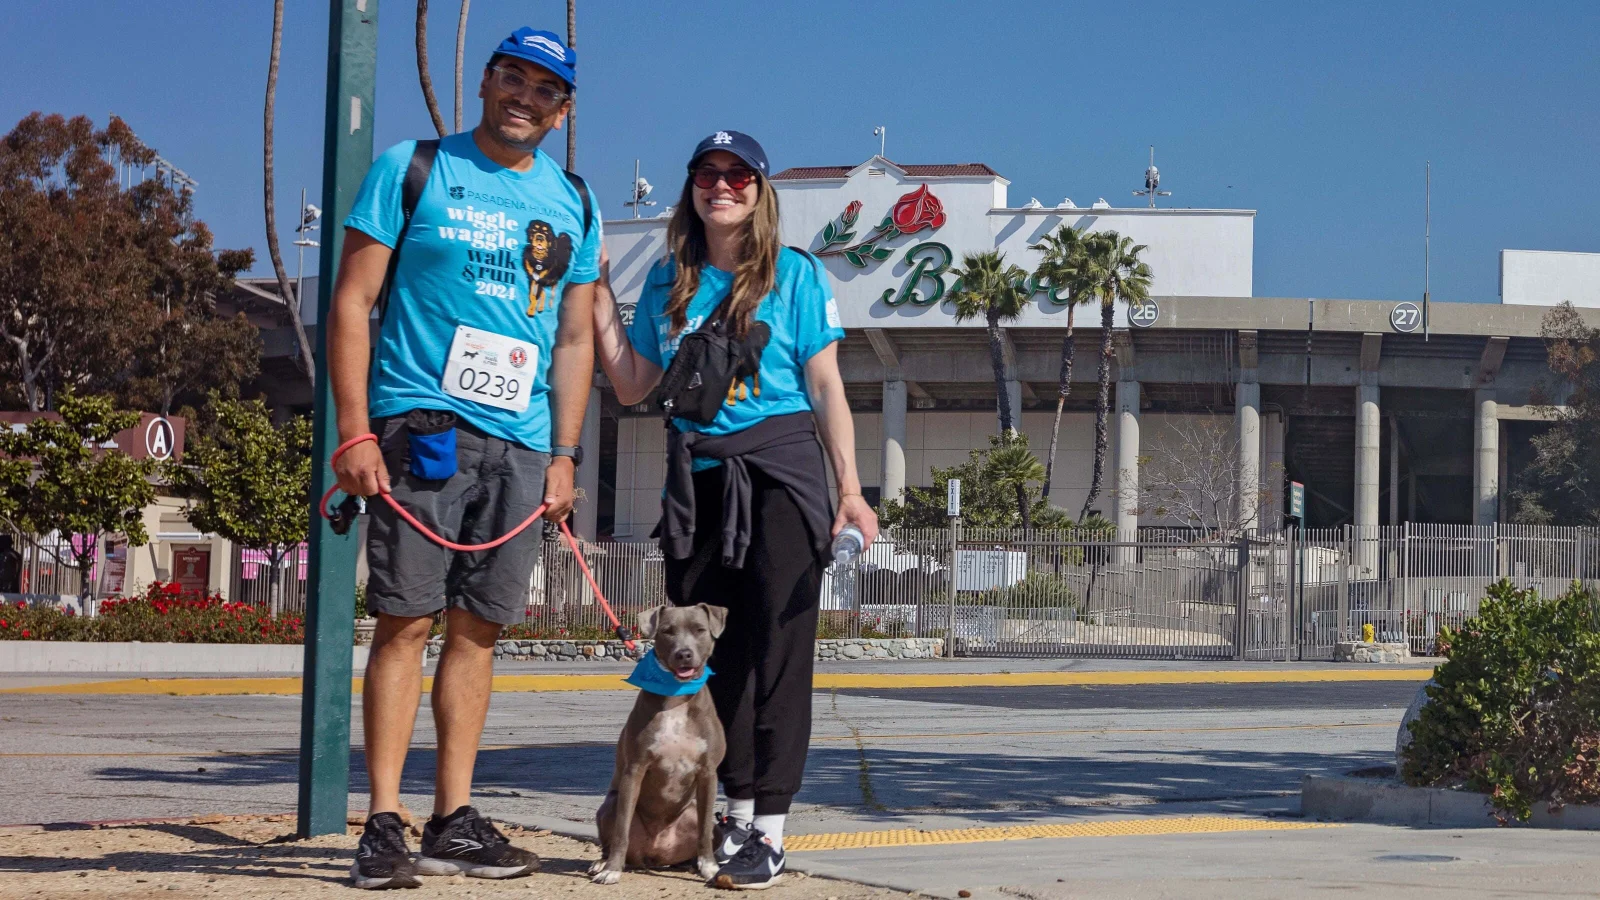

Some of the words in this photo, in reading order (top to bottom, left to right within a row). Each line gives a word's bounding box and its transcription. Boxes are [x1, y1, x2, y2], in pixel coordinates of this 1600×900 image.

[713, 131, 733, 144] LA
[467, 190, 526, 211] PASADENA
[529, 206, 571, 224] HUMANE
[446, 205, 519, 231] wiggle
[438, 226, 518, 251] waggle
[467, 249, 517, 270] walk
[462, 264, 475, 282] &
[478, 266, 516, 285] run
[475, 281, 516, 301] 2024
[1133, 304, 1156, 320] 26
[1395, 309, 1418, 325] 27
[459, 367, 520, 401] 0239
[152, 424, 166, 454] A
